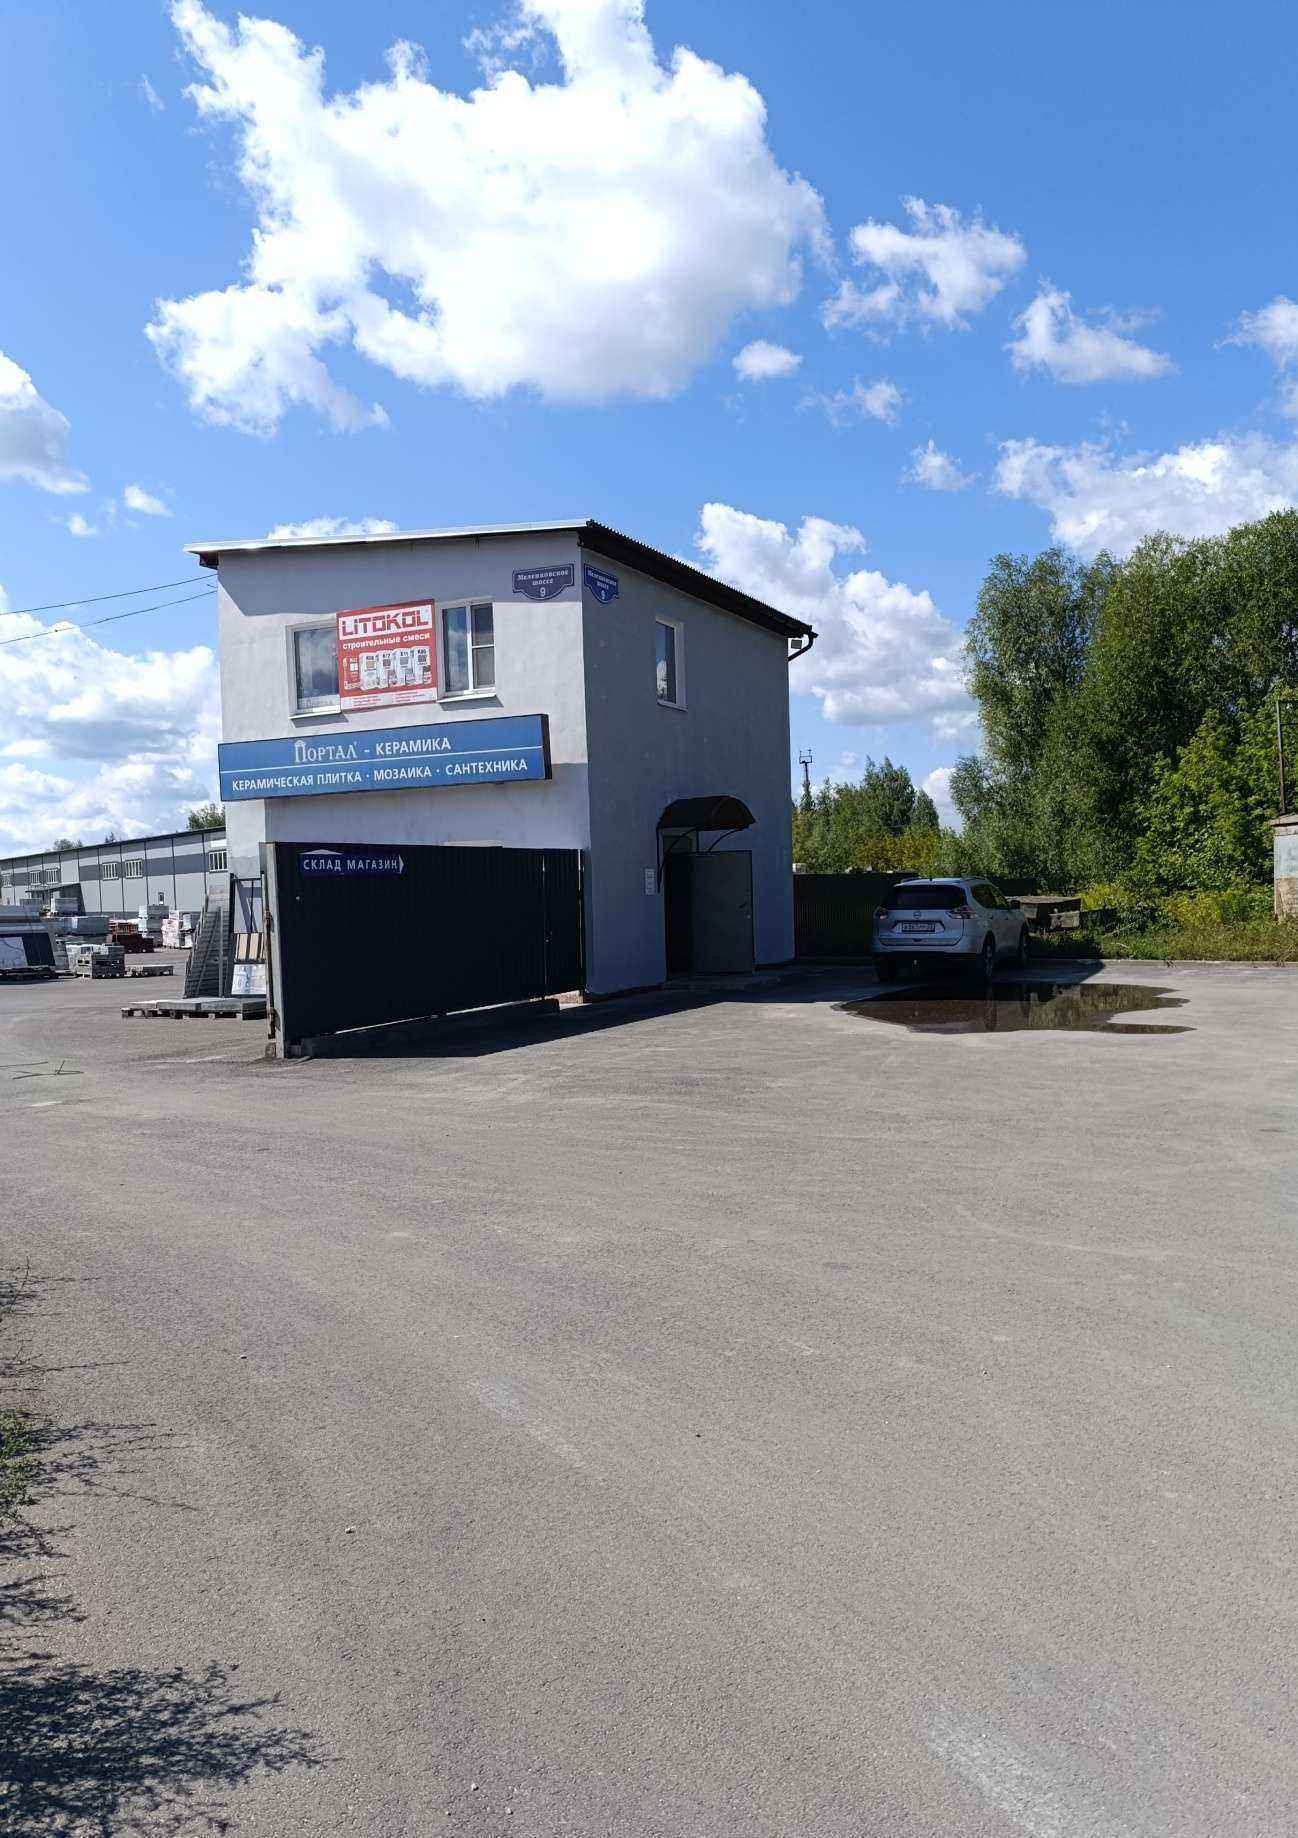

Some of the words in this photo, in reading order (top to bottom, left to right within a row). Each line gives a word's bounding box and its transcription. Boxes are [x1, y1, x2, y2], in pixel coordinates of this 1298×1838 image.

[540, 587, 546, 597] 9
[342, 637, 401, 650] строительные
[402, 632, 431, 642] смеси
[375, 737, 451, 756] КЕРАМИКА
[232, 774, 314, 792] КЕРАМИЧЕСКАЯ
[317, 771, 362, 785] ПЛИТКА
[373, 765, 432, 782] МОЗАИКА
[445, 758, 528, 776] САНТЕХНИКА
[303, 859, 342, 872] СКЛАД
[346, 859, 398, 871] МАГАЗИН
